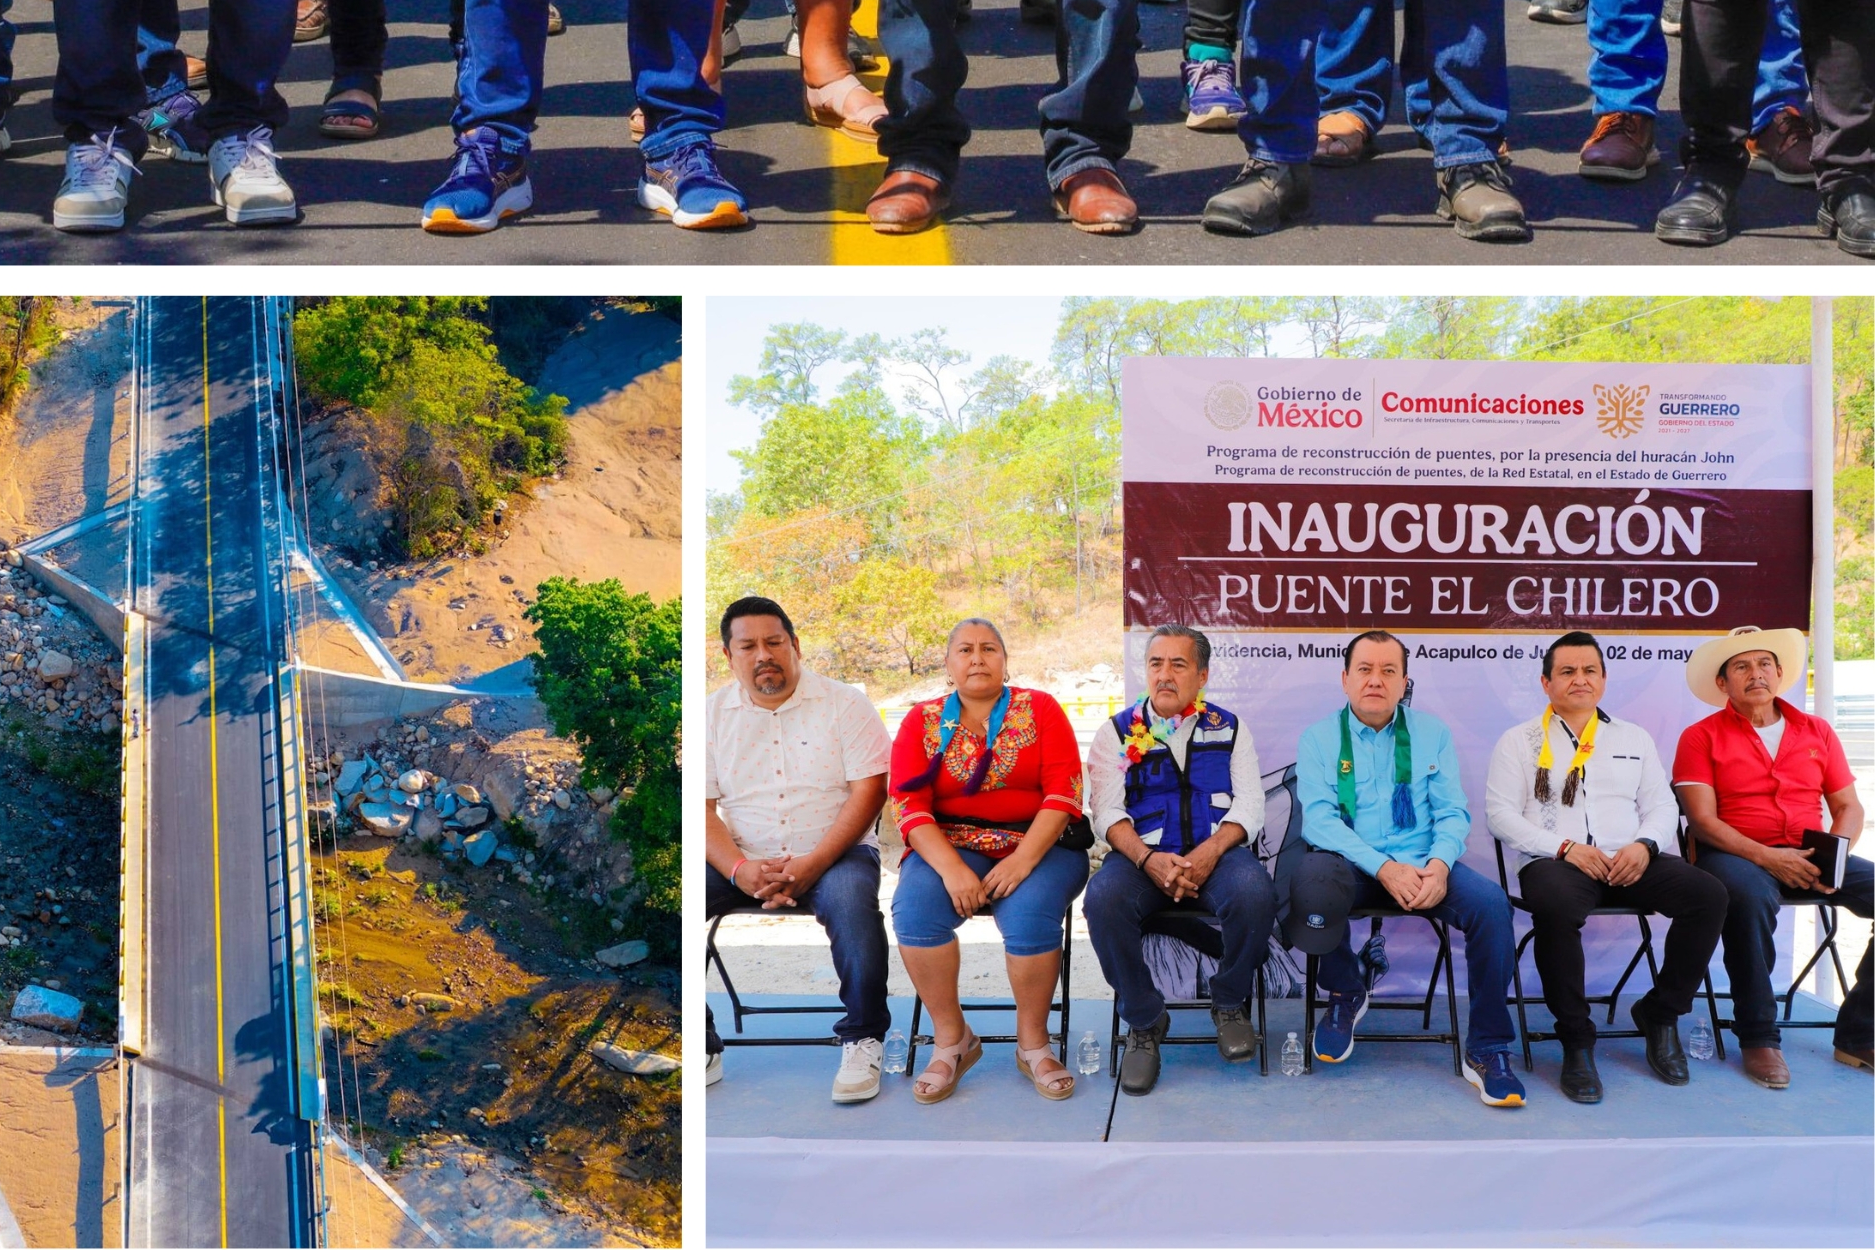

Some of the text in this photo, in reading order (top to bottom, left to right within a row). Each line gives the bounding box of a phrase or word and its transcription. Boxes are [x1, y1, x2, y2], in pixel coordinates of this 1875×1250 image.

[1258, 387, 1336, 400] Gobierno
[1342, 388, 1361, 401] de
[1382, 392, 1584, 415] Comunicaciones
[1660, 403, 1739, 415] GUERRERO
[1258, 400, 1362, 428] México
[1207, 446, 1734, 463] Programa de reconstrucción de puentes, por la presencia del huracán John
[1215, 465, 1726, 480] Programa de reconstrucción de puentes, de la Red Estatal, en el Estado de Guerrero
[1228, 489, 1705, 555] INAUGURACIÓN
[1217, 574, 1720, 618] PUENTE EL CHILERO
[1415, 645, 1497, 662] Acapulco
[1503, 646, 1524, 659] de
[1607, 646, 1626, 659] 02
[1632, 647, 1652, 659] de
